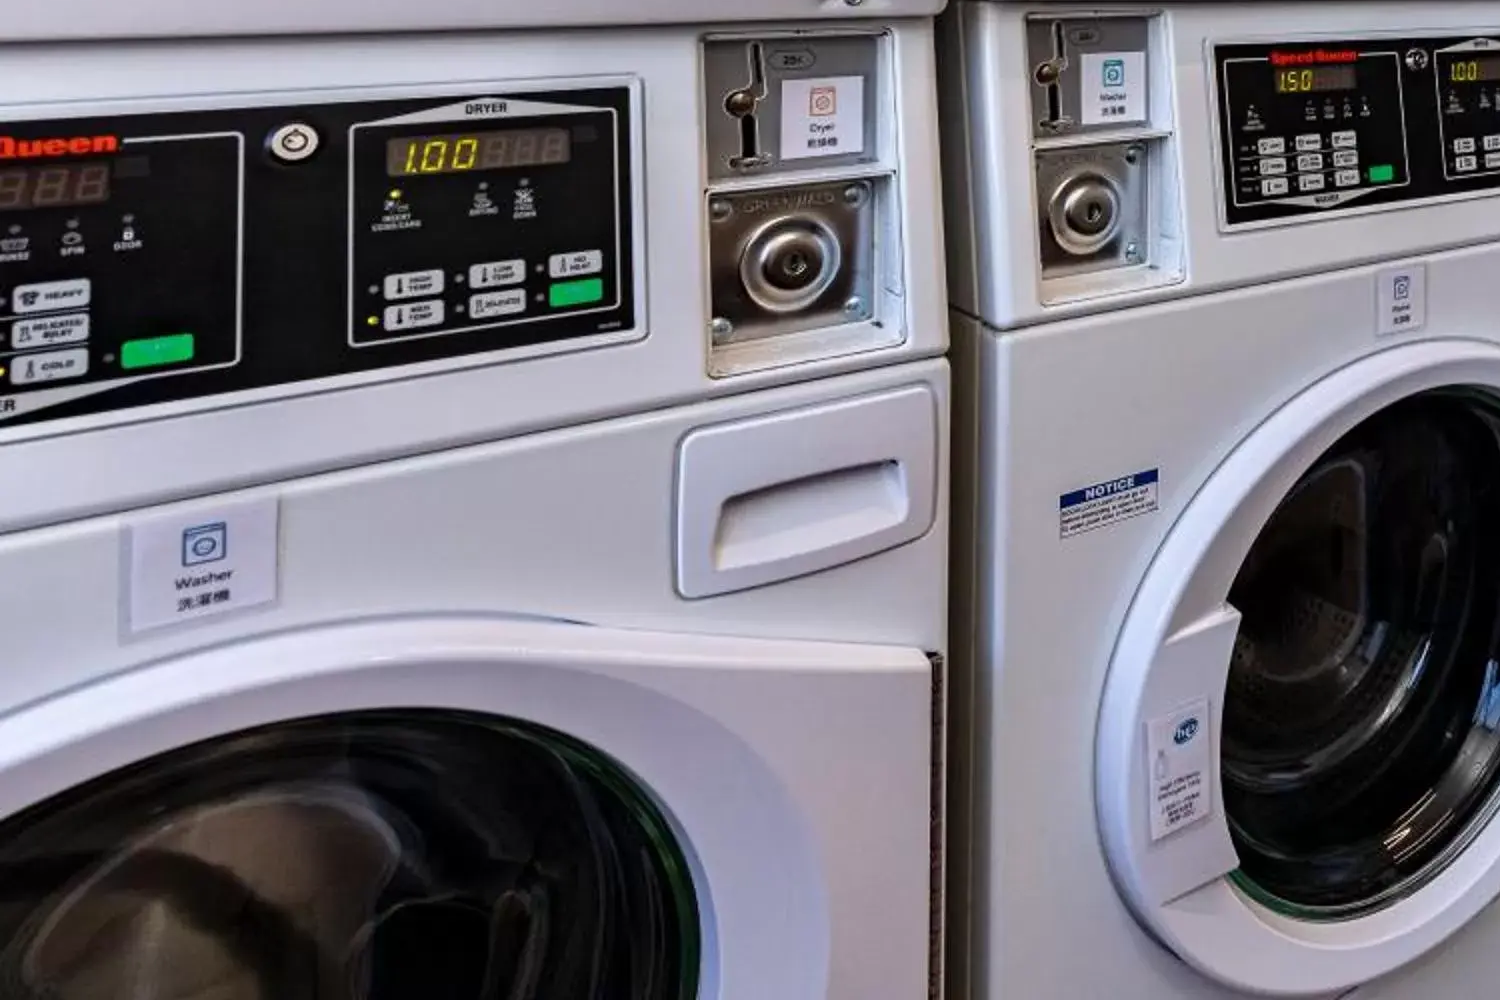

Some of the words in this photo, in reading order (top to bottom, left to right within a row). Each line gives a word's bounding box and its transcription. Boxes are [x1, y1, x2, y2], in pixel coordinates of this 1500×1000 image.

[465, 101, 507, 115] DRYER
[1084, 476, 1135, 500] NOTICE
[174, 570, 234, 591] Washer
